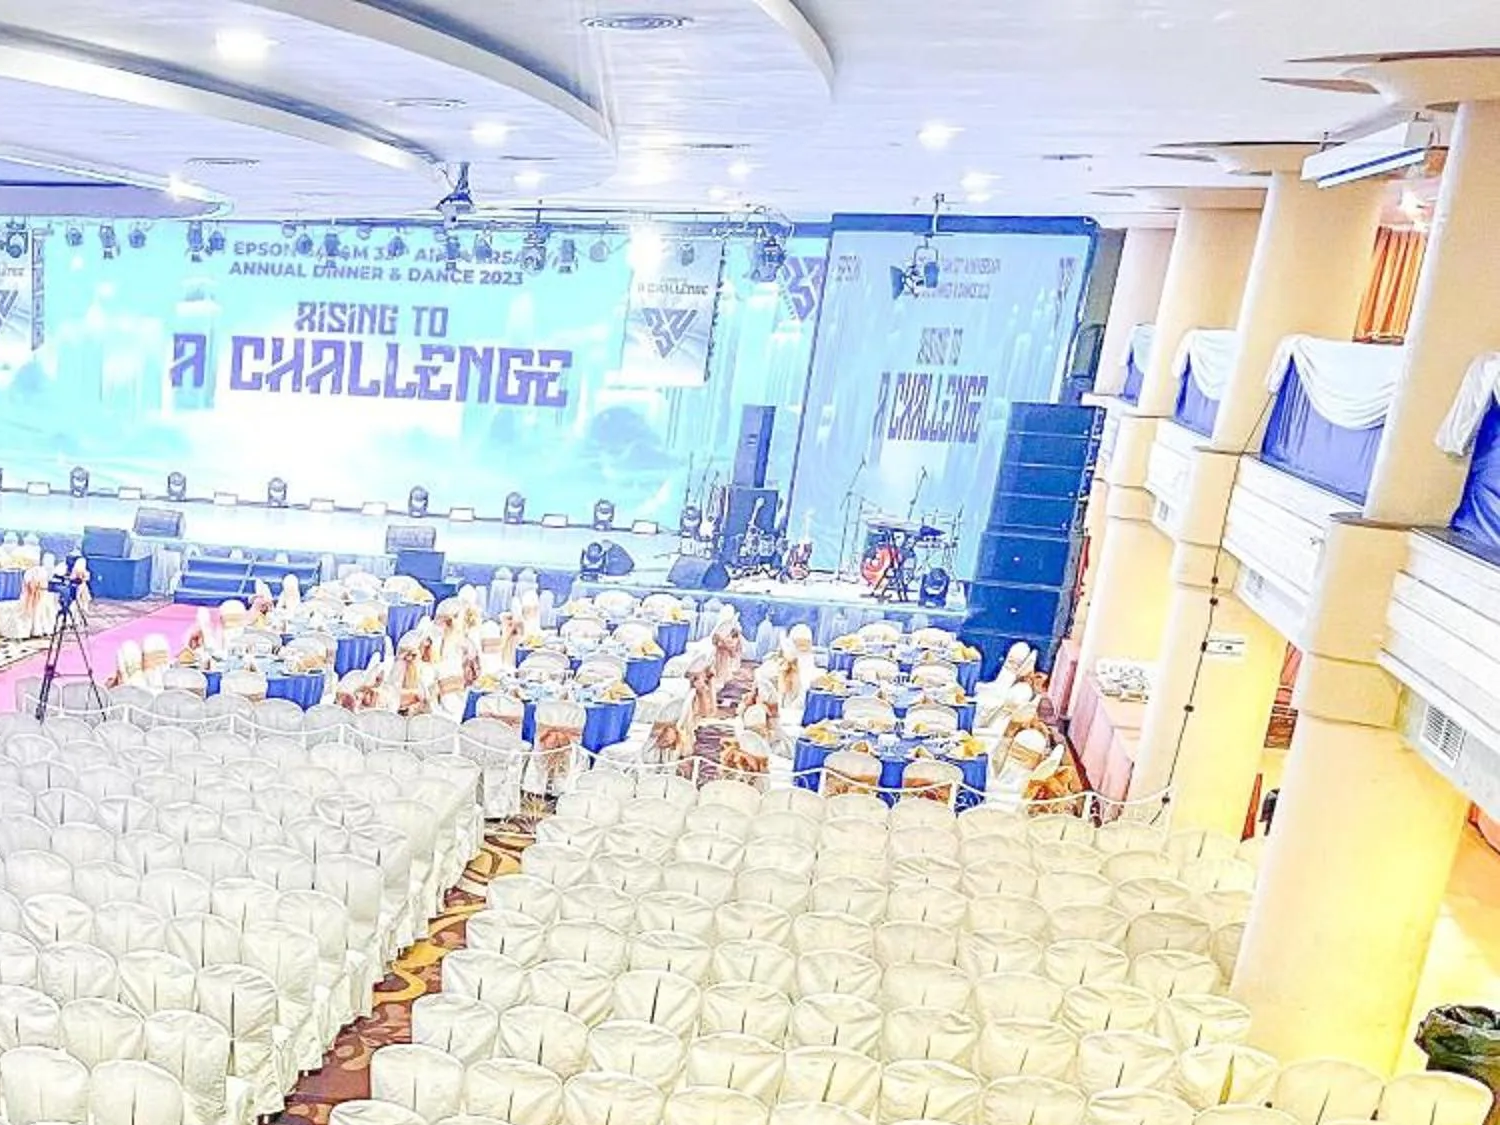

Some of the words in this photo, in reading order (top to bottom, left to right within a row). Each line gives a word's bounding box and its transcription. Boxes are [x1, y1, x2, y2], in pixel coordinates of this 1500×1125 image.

[229, 261, 307, 278] ANNUAL
[313, 264, 384, 280] DINNER
[389, 269, 400, 281] &
[408, 268, 475, 284] DANCE
[480, 271, 524, 285] 2023
[294, 301, 399, 336] RISING
[412, 305, 449, 338] TO
[170, 333, 207, 388] A
[230, 335, 573, 408] CHALLENGE
